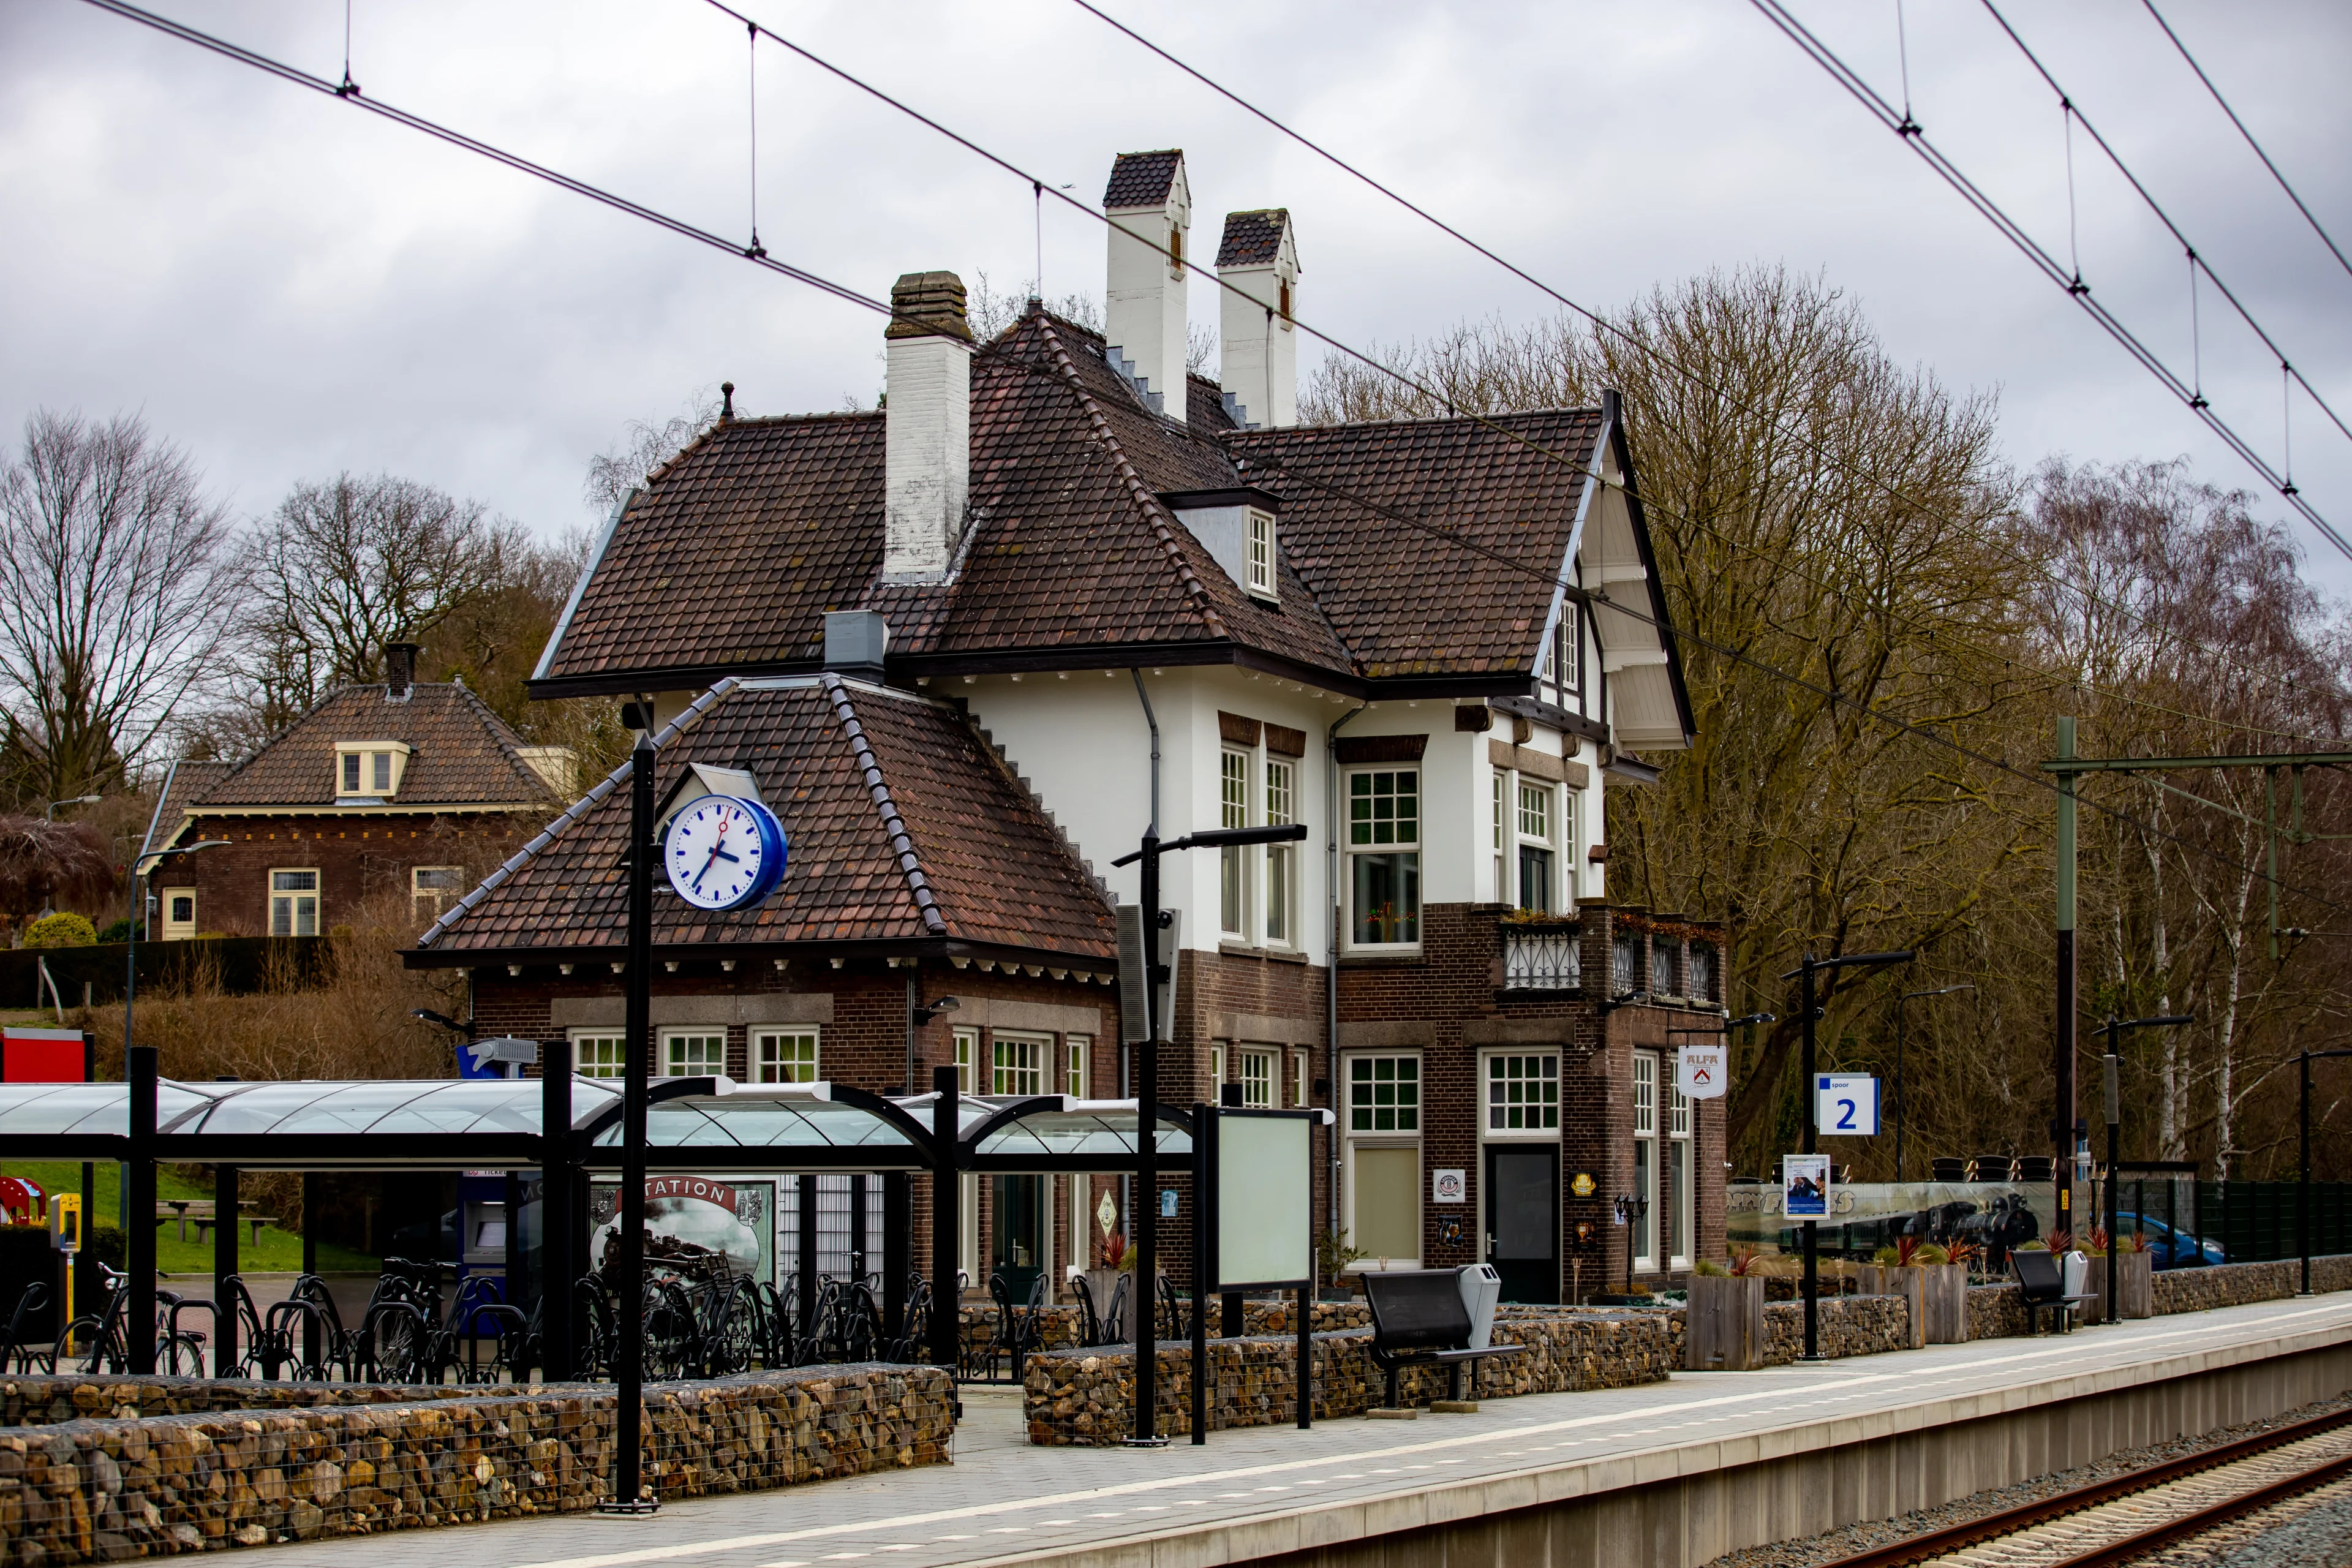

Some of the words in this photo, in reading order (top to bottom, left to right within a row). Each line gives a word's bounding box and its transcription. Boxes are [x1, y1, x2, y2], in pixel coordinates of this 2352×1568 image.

[1686, 1055, 1718, 1065] ALFA
[1836, 1099, 1856, 1129] 2
[645, 1180, 725, 1202] TATION
[1726, 1193, 1763, 1207] APPY
